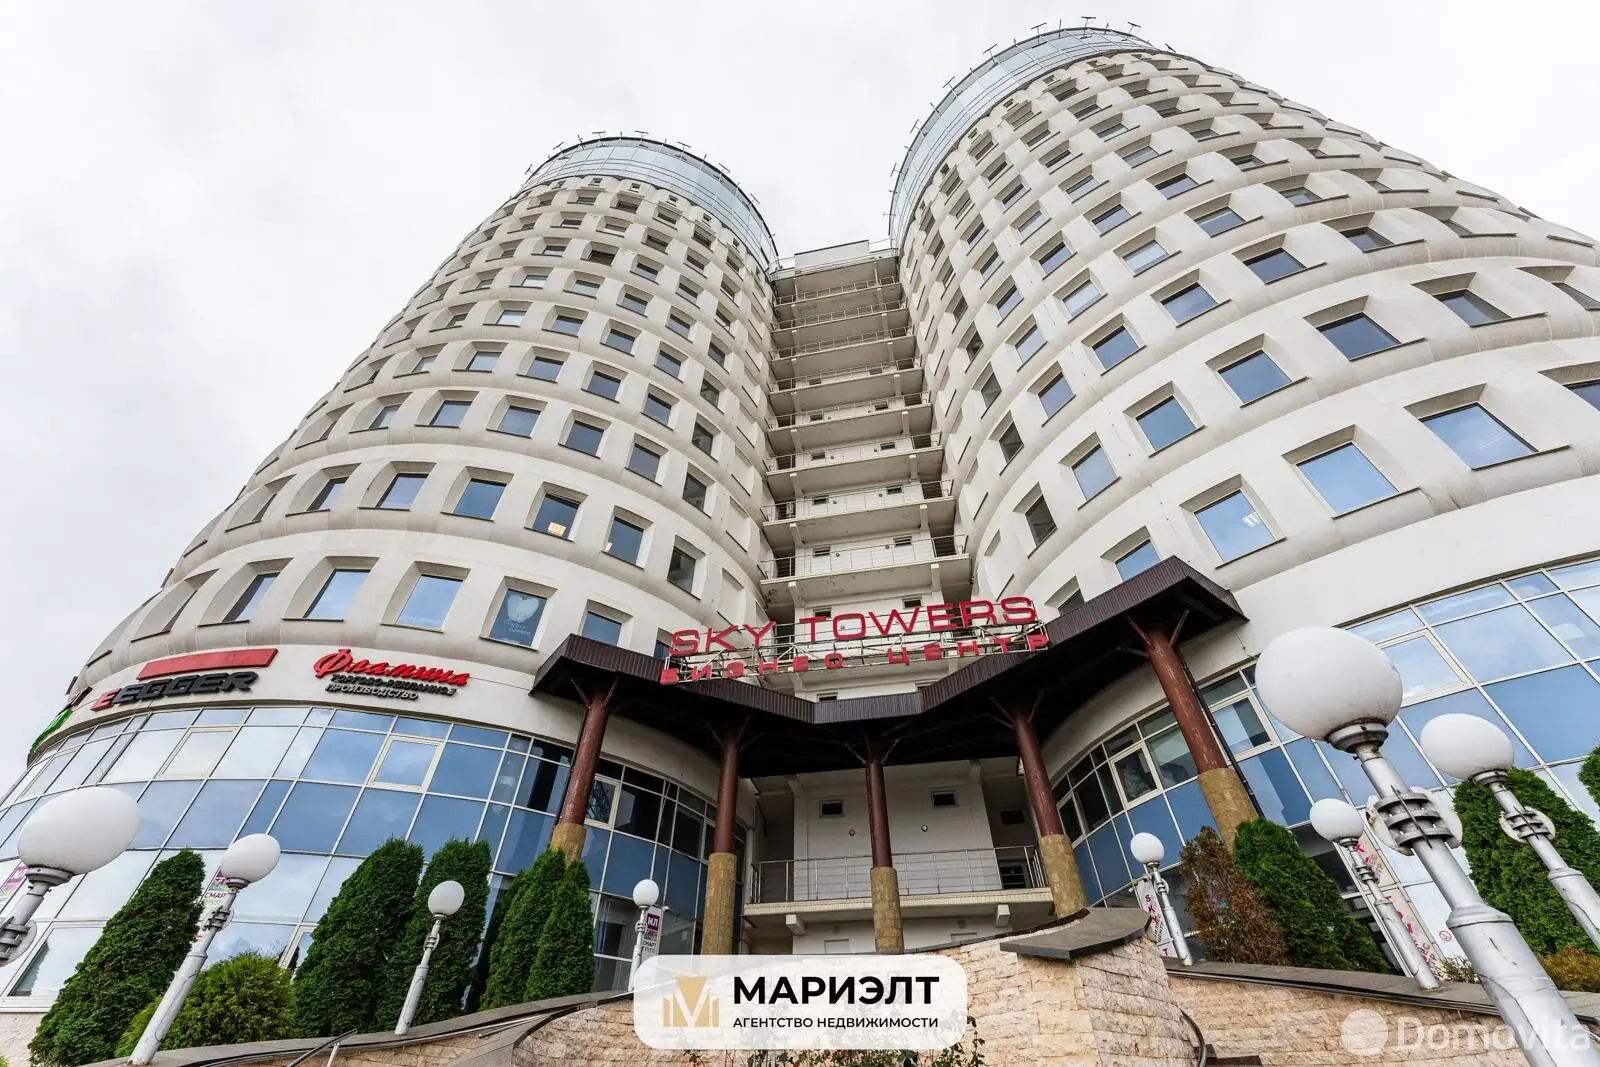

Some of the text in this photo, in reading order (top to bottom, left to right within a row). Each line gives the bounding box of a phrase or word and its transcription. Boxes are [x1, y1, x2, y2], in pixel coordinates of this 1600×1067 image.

[669, 596, 1037, 656] SKY TOWERS
[313, 648, 471, 686] Фламина
[660, 634, 1050, 686] БИЗНЕС ЦЕНТР
[325, 683, 419, 700] ПРОИЗВОДСТВО
